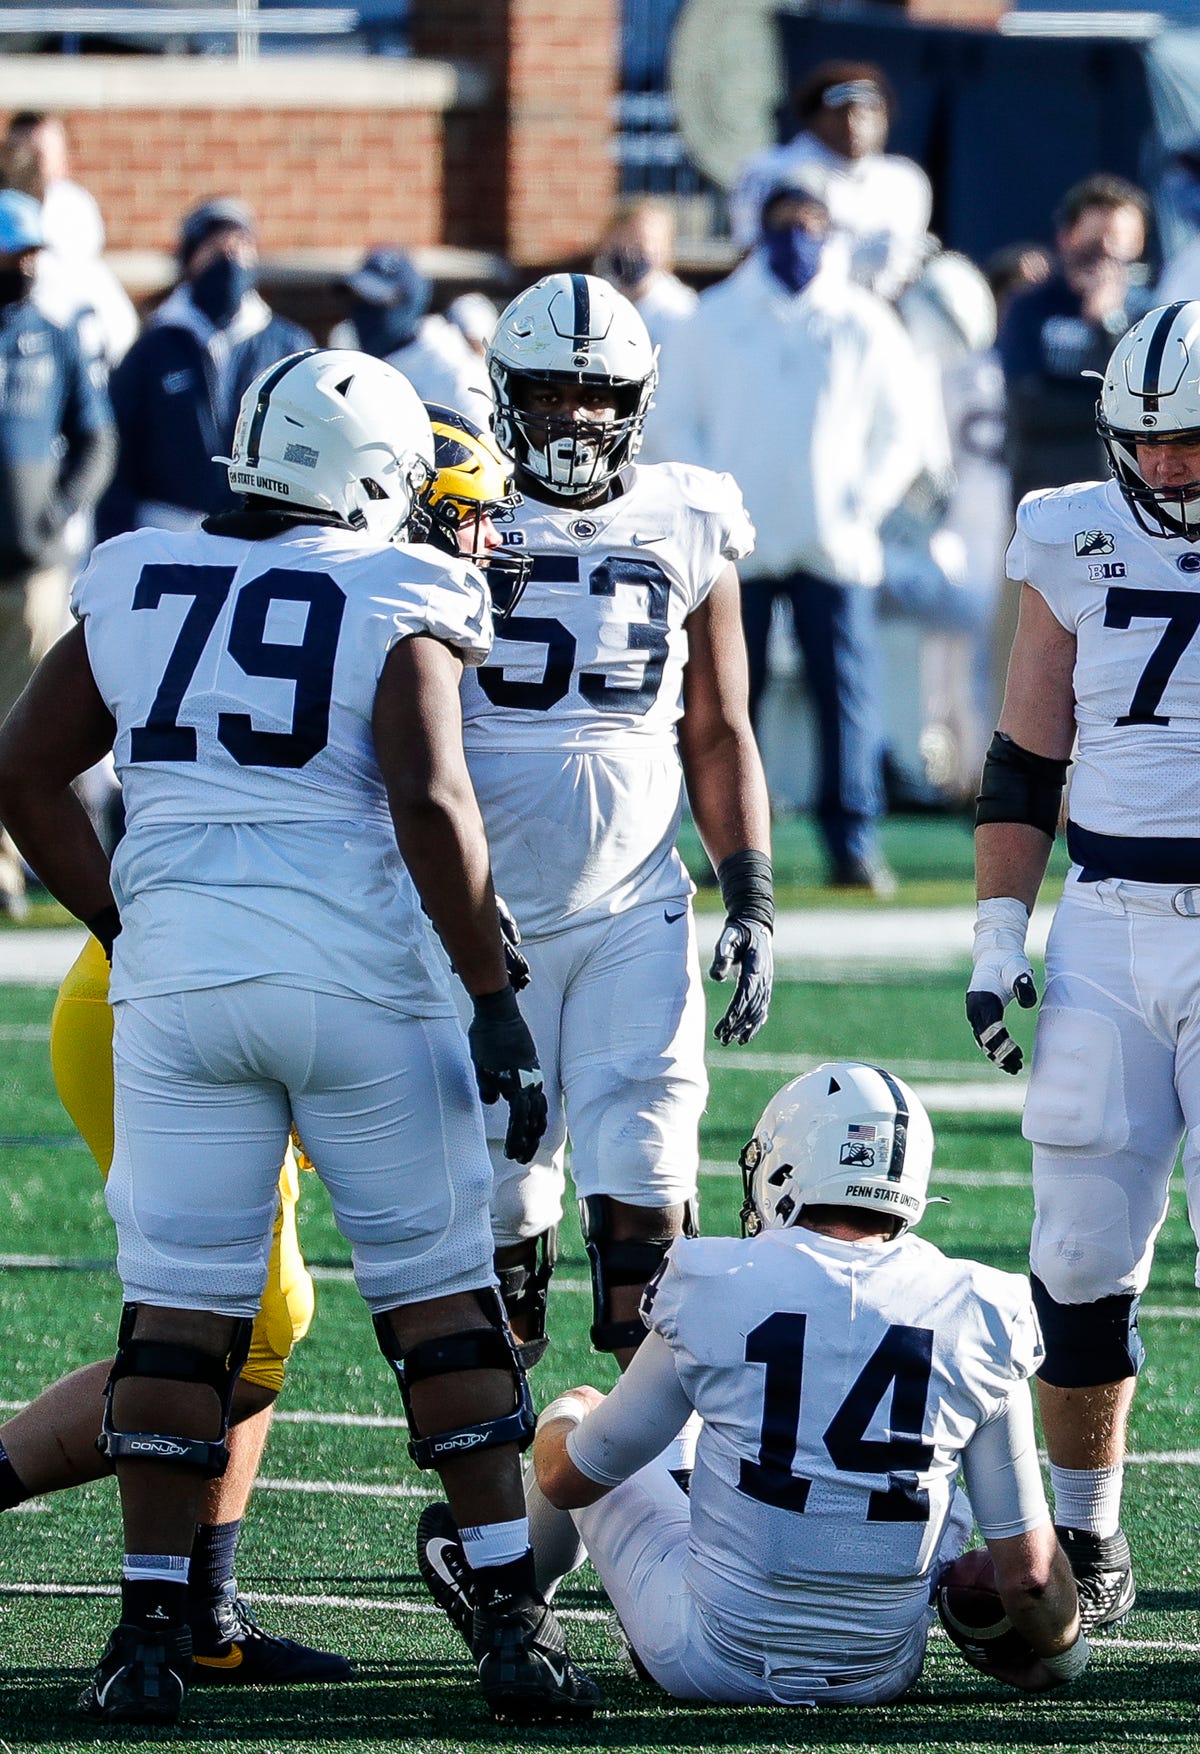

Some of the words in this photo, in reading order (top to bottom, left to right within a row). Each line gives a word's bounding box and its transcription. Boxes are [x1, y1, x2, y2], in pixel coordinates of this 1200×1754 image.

[237, 472, 256, 487] STATE
[256, 475, 290, 495] UNITED
[500, 531, 524, 546] IG
[1088, 562, 1127, 581] BIG
[477, 554, 672, 715] 53
[130, 563, 347, 769] 79
[845, 1185, 873, 1198] PENN
[873, 1187, 900, 1203] STATE
[735, 1311, 935, 1522] 14
[130, 1440, 189, 1455] DONJOY
[435, 1431, 491, 1452] DONJOY
